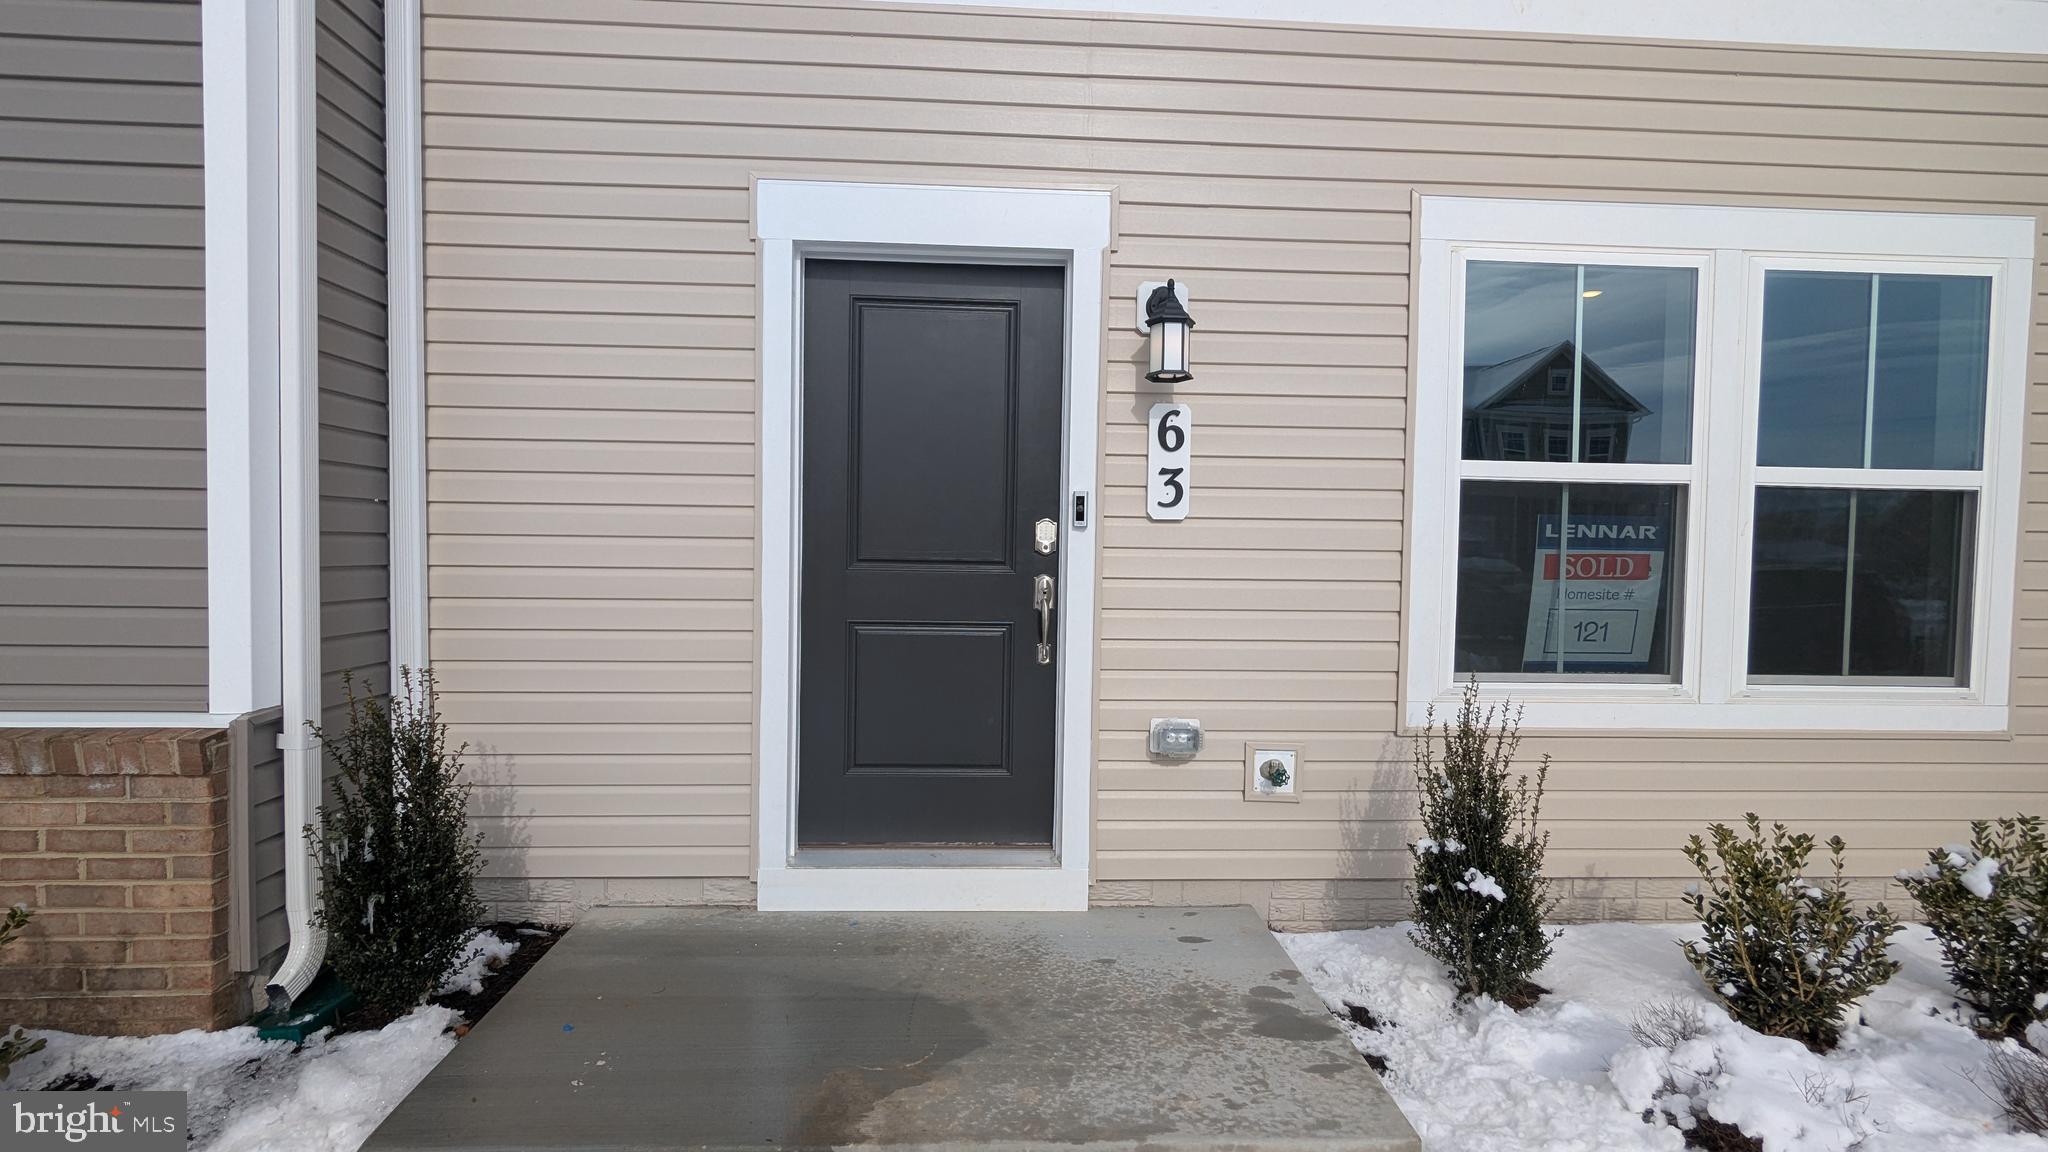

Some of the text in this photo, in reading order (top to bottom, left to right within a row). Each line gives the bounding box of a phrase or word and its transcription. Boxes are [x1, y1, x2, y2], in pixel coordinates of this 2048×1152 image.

[1545, 524, 1657, 540] LENNAR
[1565, 556, 1635, 578] SOLD
[1623, 588, 1636, 601] #
[1573, 621, 1610, 643] 121
